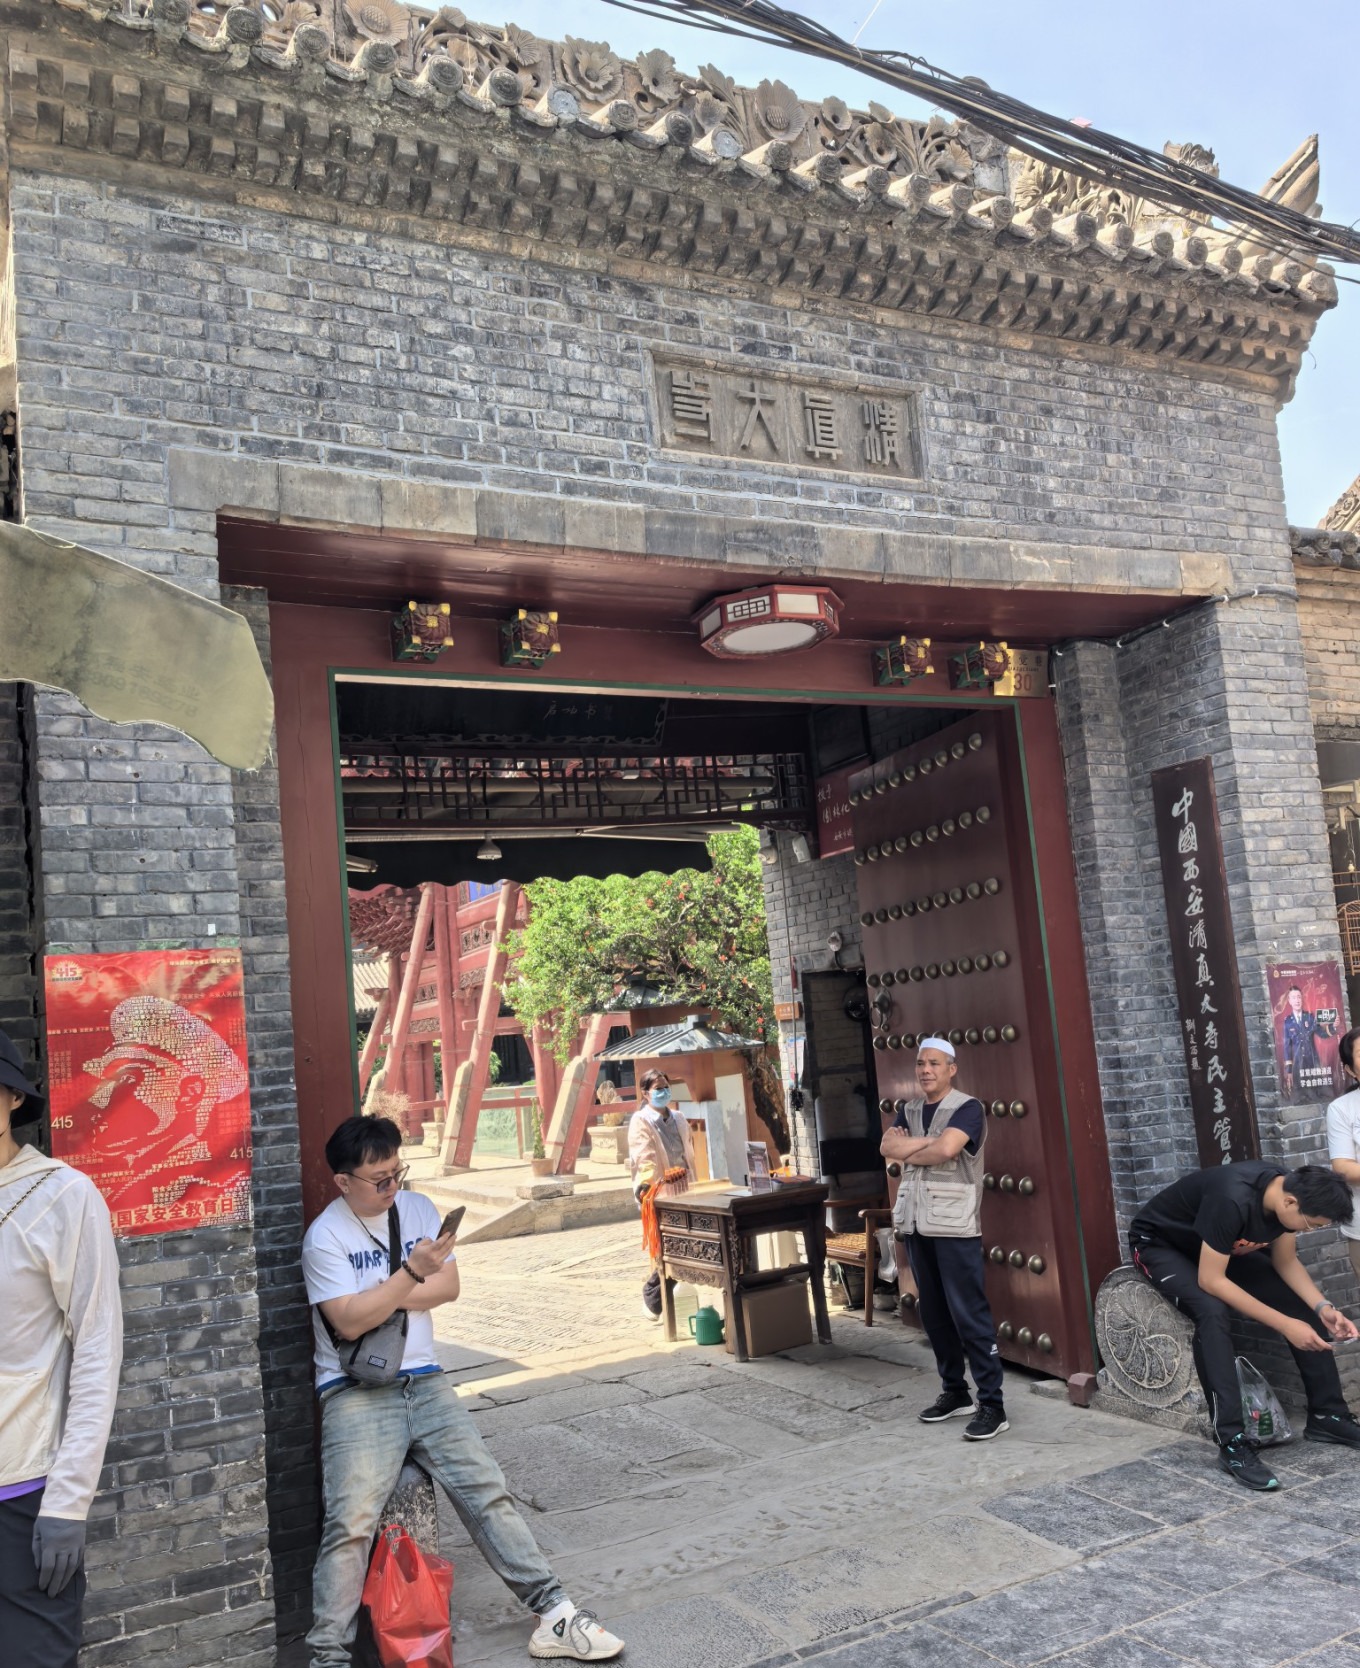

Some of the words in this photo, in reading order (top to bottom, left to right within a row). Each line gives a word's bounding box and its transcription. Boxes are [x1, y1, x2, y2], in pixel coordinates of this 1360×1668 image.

[1013, 673, 1032, 691] 30
[50, 1115, 74, 1129] 415
[230, 1147, 254, 1160] 415
